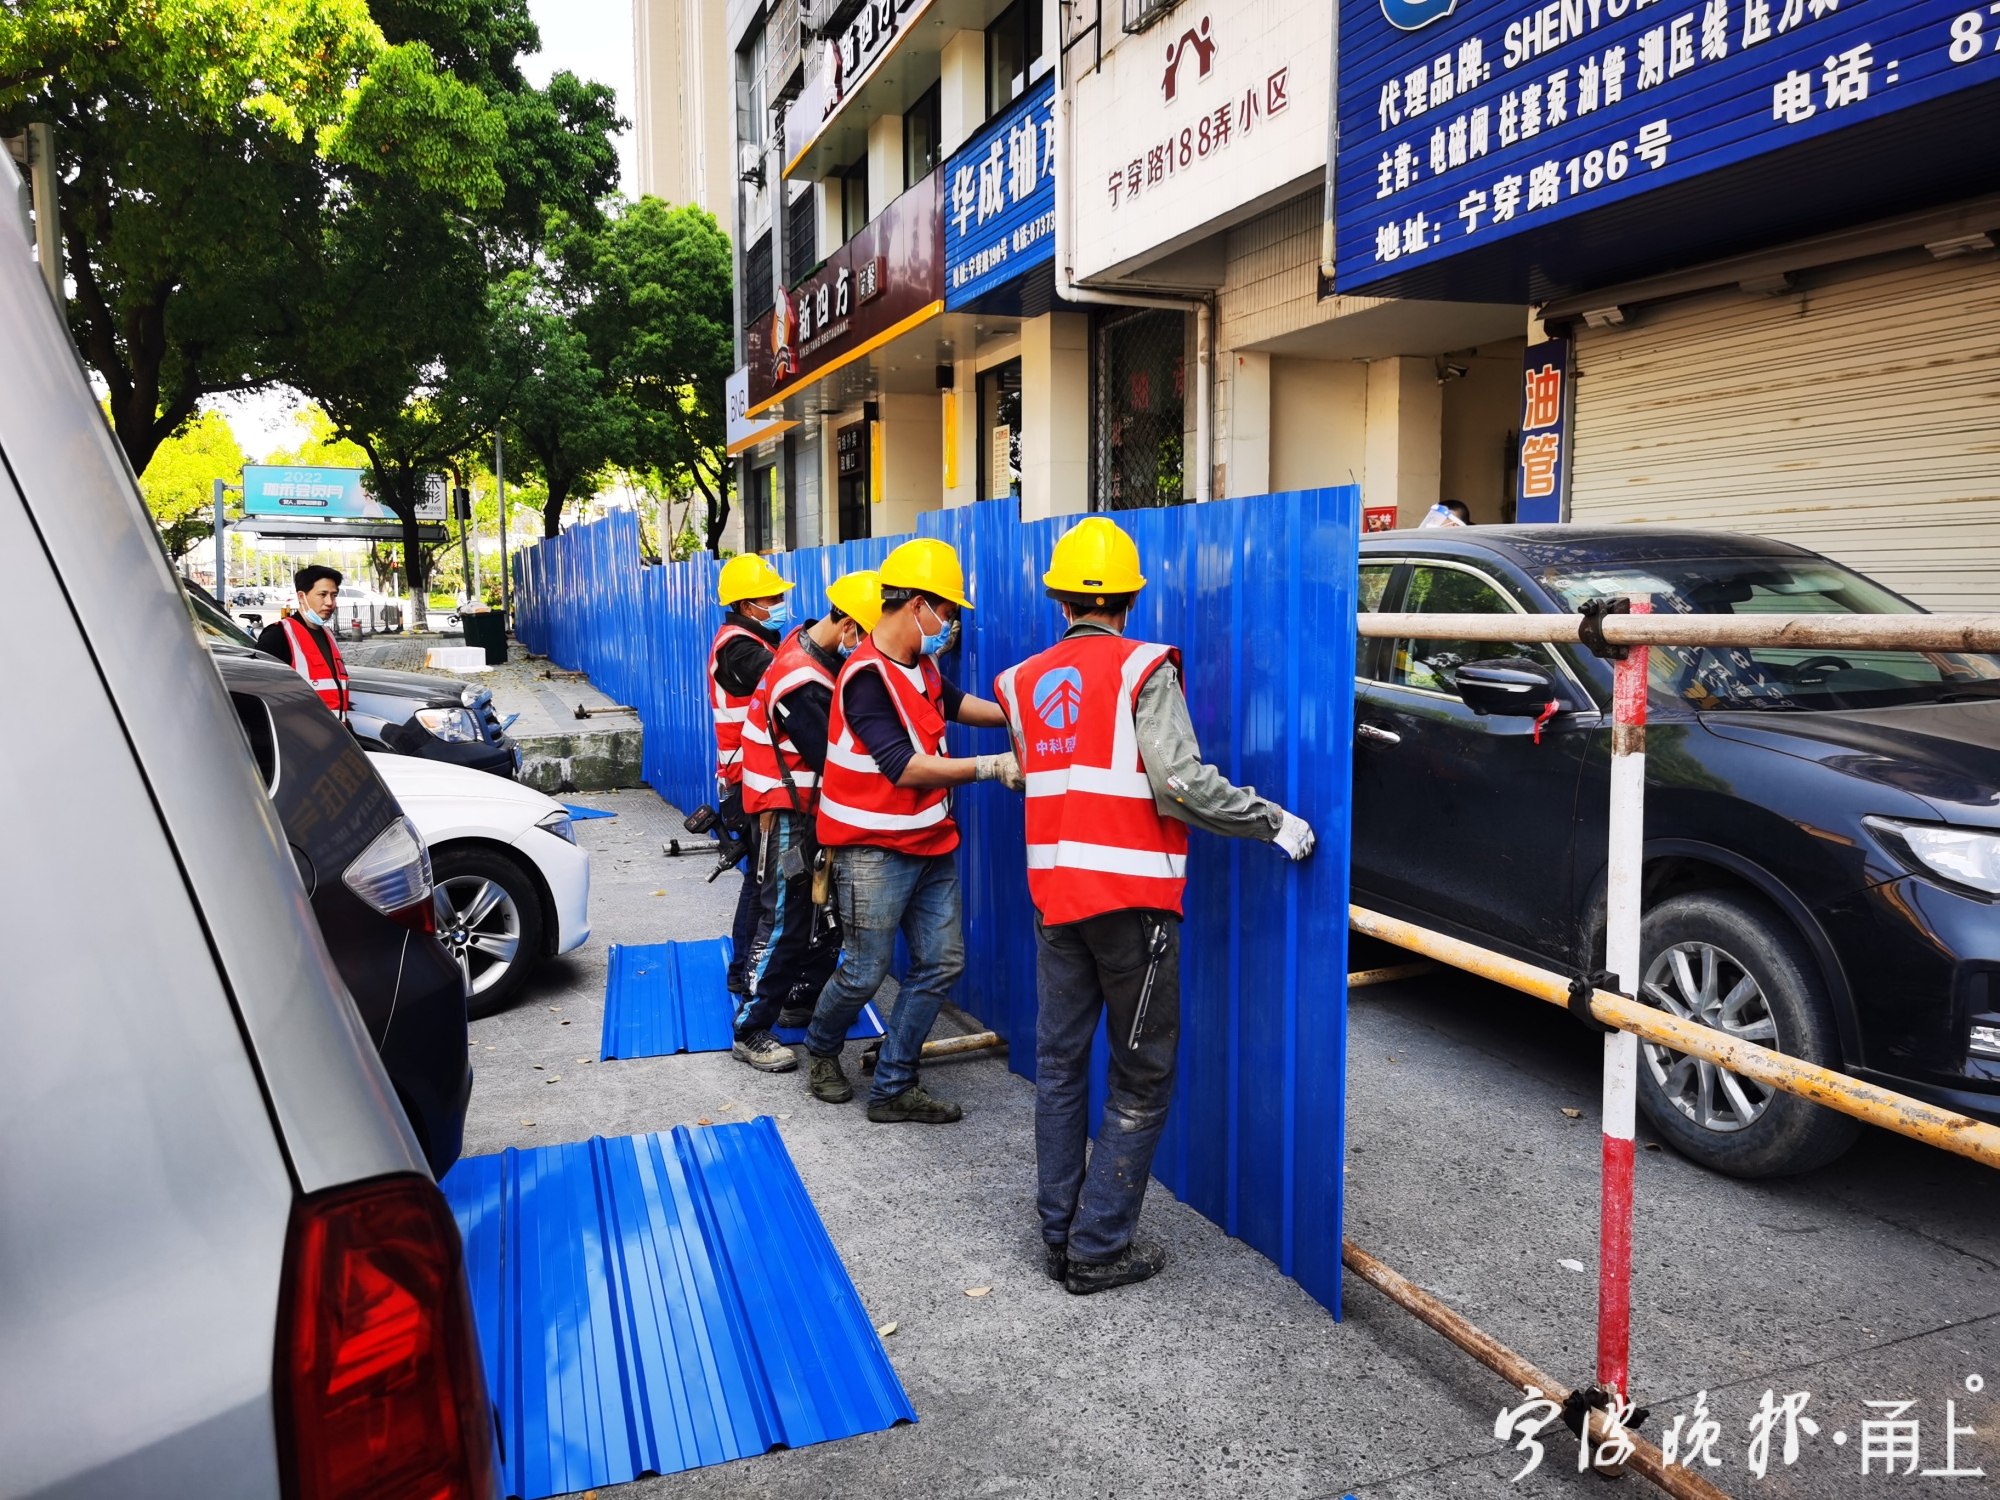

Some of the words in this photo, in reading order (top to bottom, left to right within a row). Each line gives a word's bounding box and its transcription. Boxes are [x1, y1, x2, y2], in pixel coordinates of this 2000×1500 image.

[1376, 142, 1419, 199] 主营：
[1430, 106, 1489, 175] 电磁阀
[1499, 69, 1568, 147] 柱塞泵
[1577, 45, 1626, 117] 油管
[1637, 0, 1729, 90] 测压线
[1378, 37, 1491, 131] 代理品牌：
[1503, 0, 1658, 69] SHENY
[1773, 42, 1899, 123] 电话：
[1948, 3, 2000, 63] 8
[1108, 66, 1288, 207] 宁穿路188弄小区
[1375, 212, 1441, 262] 地址：
[1459, 118, 1672, 234] 宁穿路186号
[799, 266, 849, 342] 新四方
[283, 472, 322, 483] 2022
[1522, 364, 1561, 498] 油管
